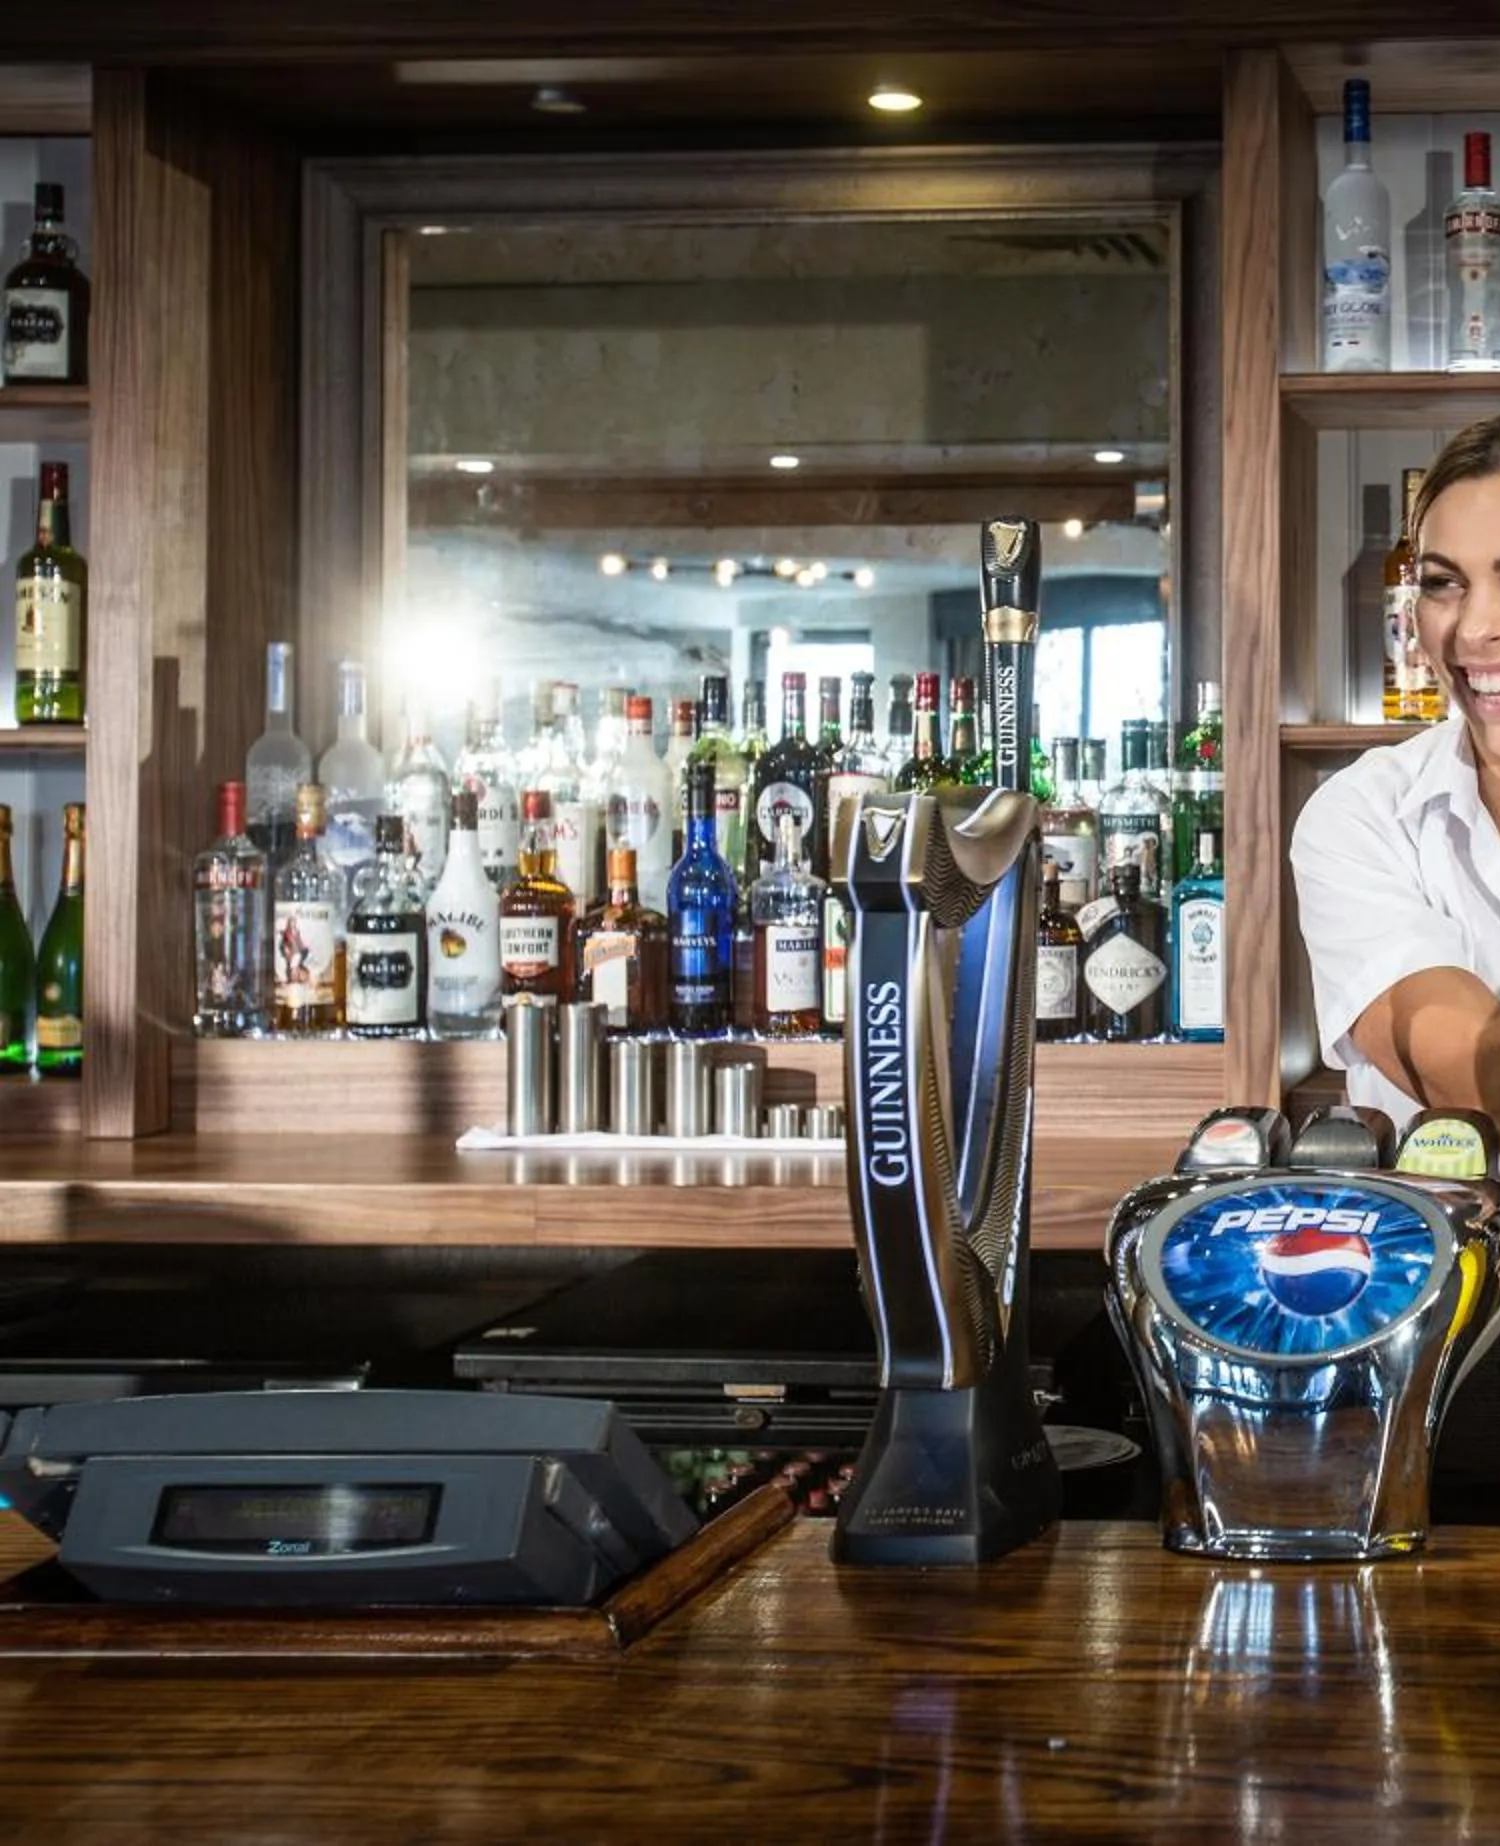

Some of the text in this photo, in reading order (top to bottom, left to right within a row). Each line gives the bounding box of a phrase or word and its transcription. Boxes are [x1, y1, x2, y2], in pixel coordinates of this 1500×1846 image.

[999, 665, 1017, 767] GUINNESS
[866, 981, 910, 1187] GUINNESS
[1210, 1206, 1380, 1237] PEPSI
[267, 1541, 311, 1554] Zonal
